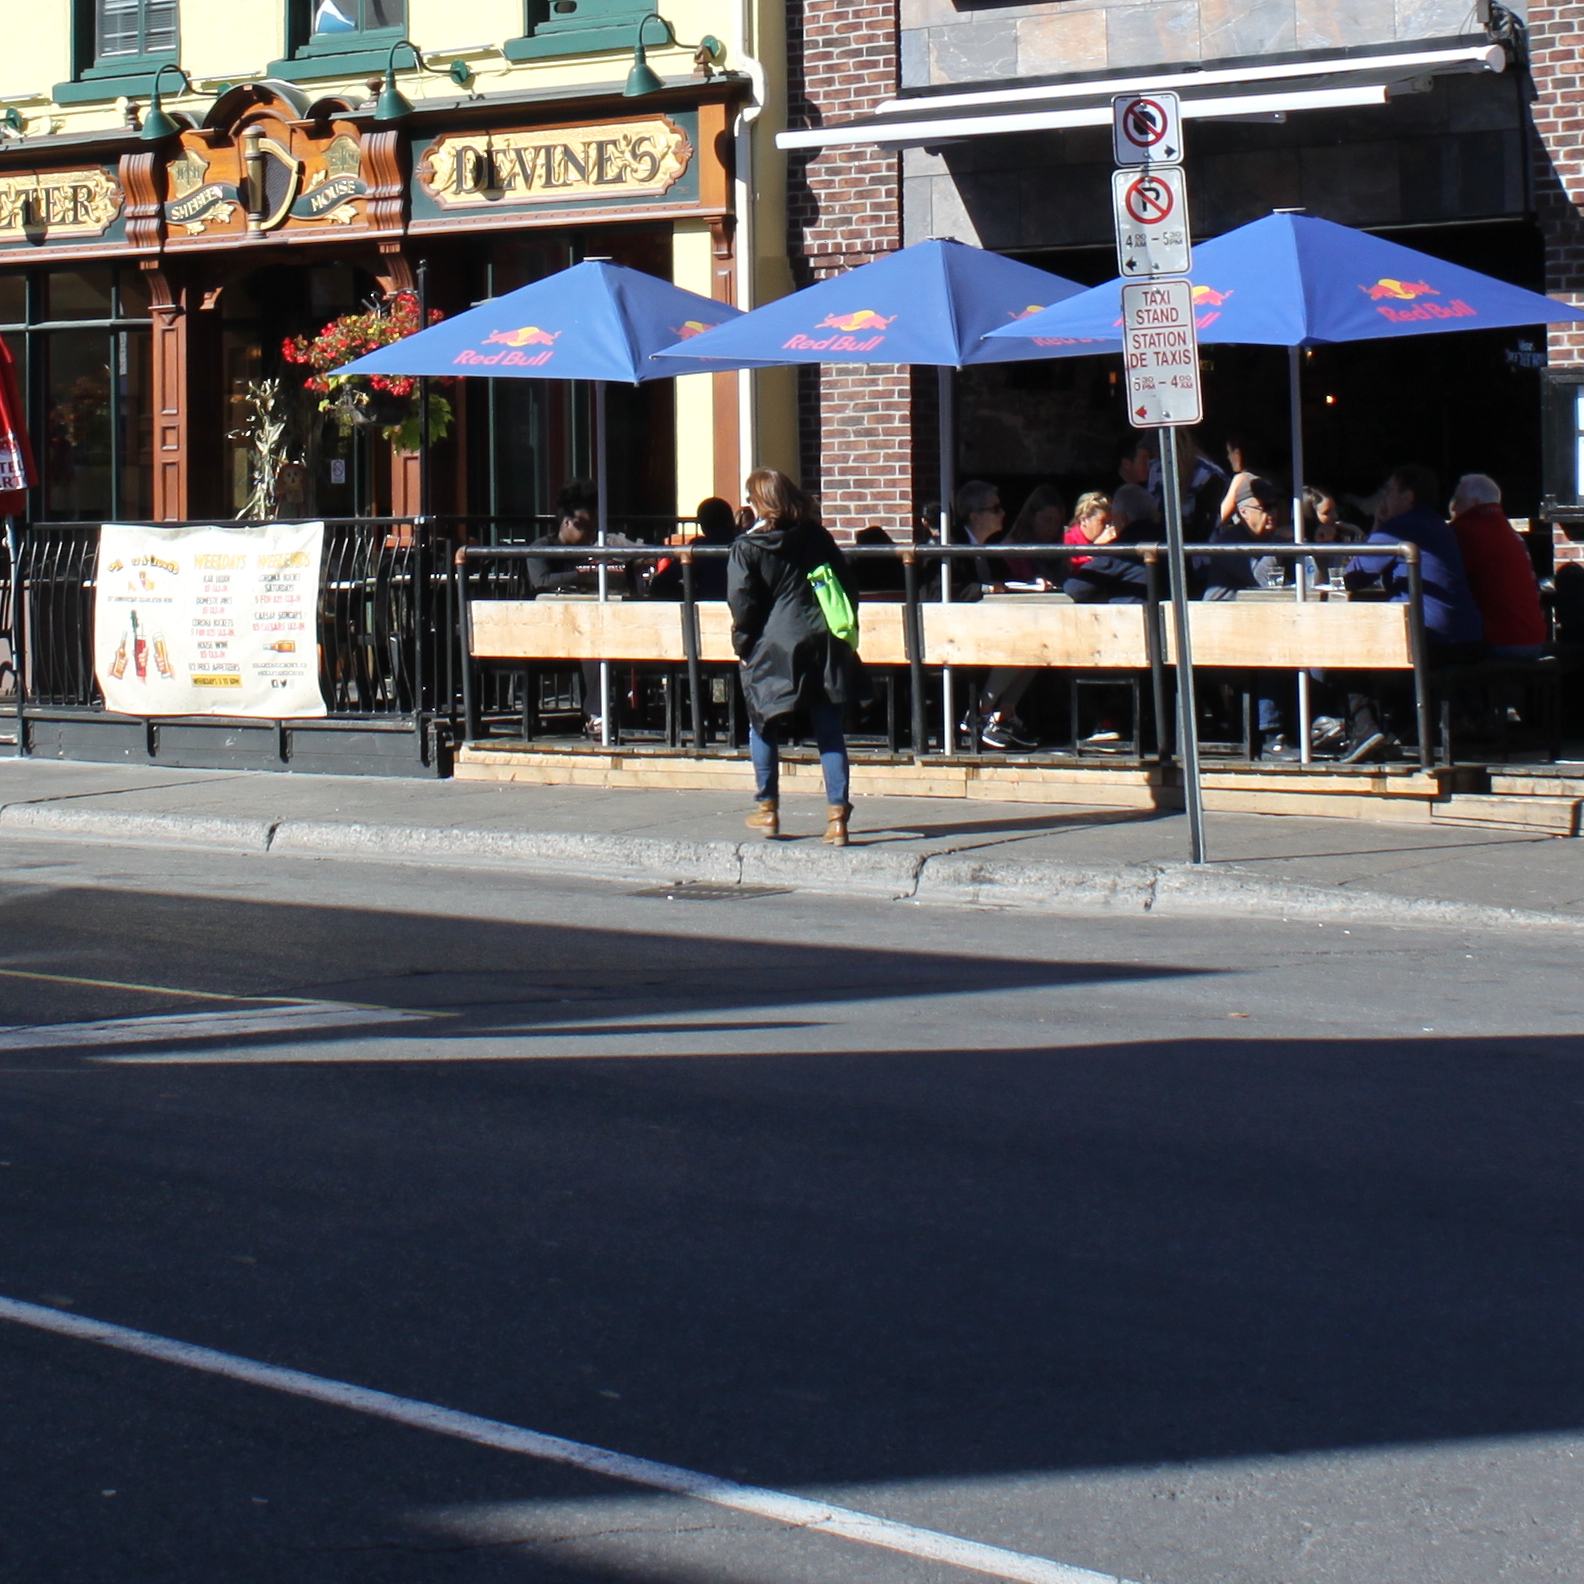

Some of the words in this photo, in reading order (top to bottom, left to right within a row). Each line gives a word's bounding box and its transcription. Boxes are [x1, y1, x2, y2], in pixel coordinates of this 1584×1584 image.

[452, 133, 664, 195] DEVINE'S
[1141, 290, 1171, 307] TAXI
[1135, 307, 1179, 326] STAND
[1132, 330, 1187, 350] STATION
[1130, 352, 1149, 369] DE
[1153, 348, 1192, 367] TAXIS
